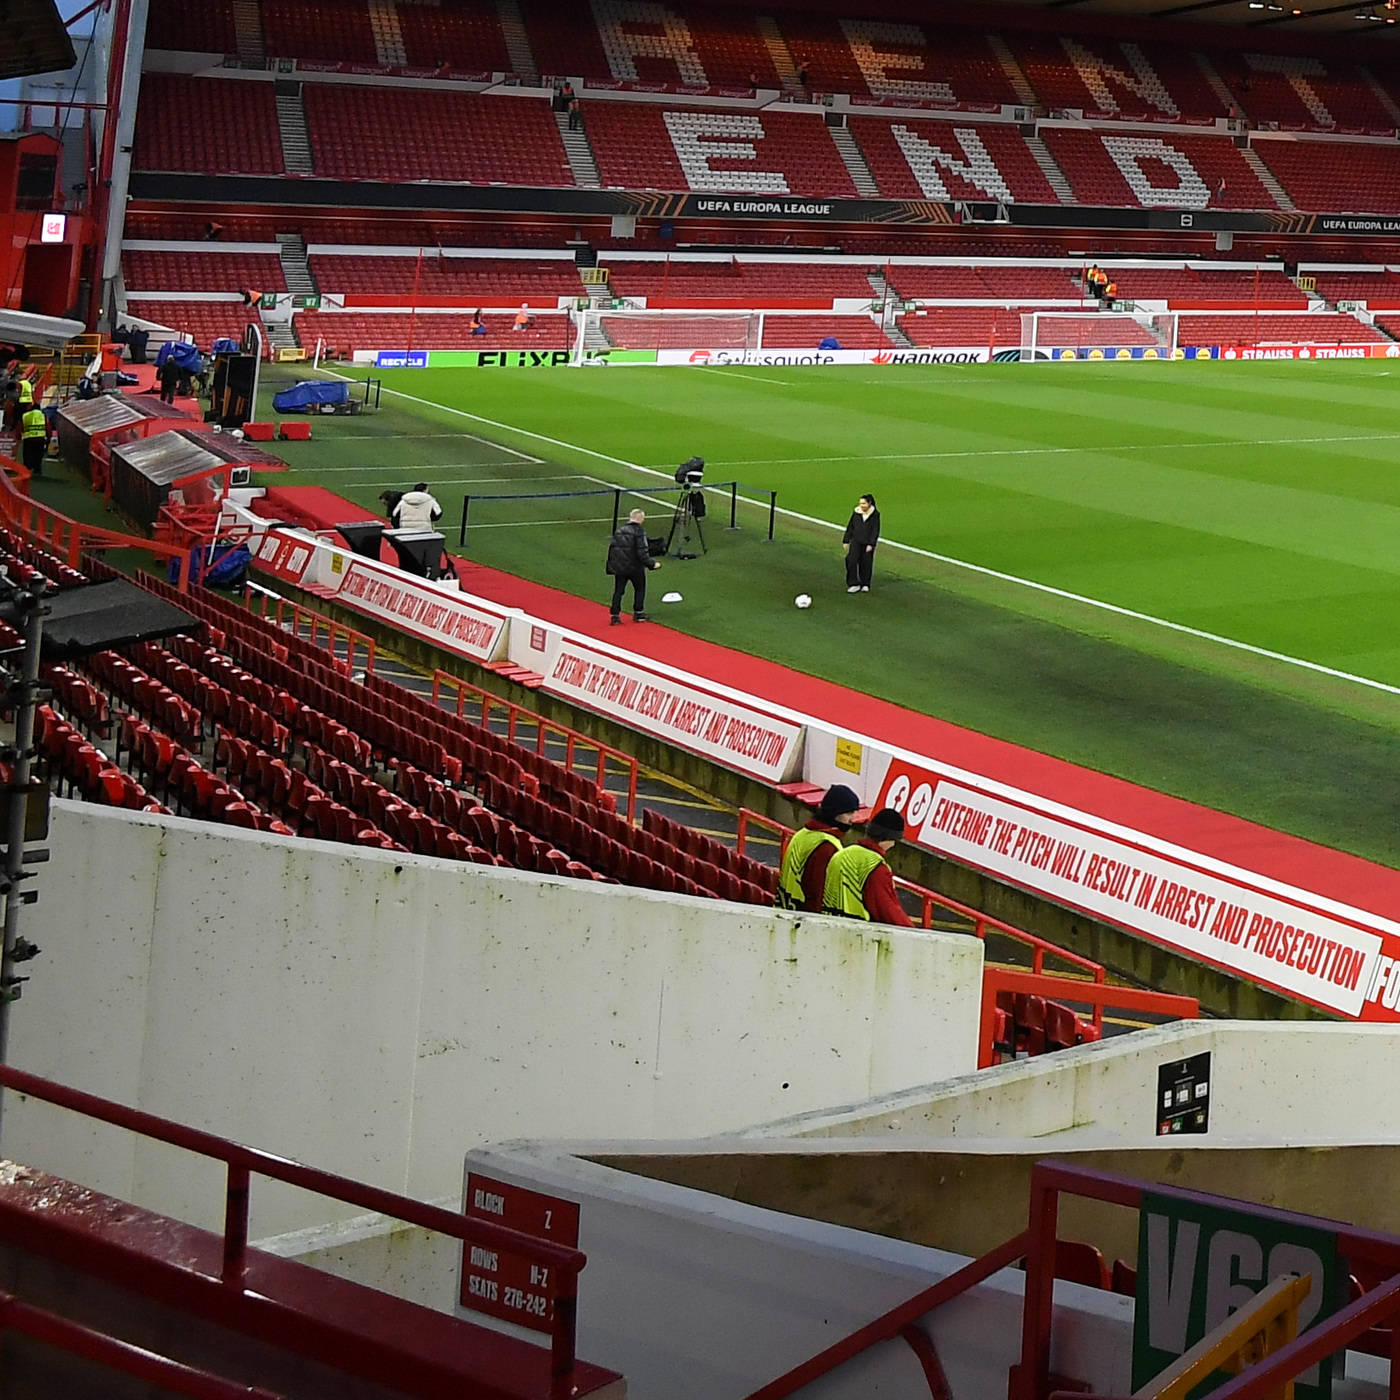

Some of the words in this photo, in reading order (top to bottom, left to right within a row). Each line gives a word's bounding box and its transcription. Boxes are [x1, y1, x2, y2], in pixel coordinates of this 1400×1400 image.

[661, 111, 1211, 207] END
[697, 201, 731, 212] UEFA
[733, 202, 781, 213] EUROPA
[784, 203, 830, 215] LEAGUE
[1323, 220, 1347, 229] UEFA
[1348, 221, 1381, 230] EUROPA
[1241, 348, 1294, 360] STRAUSS
[1315, 348, 1366, 359] STRAUSS
[552, 652, 592, 687] ENTERING
[584, 664, 605, 694] THE
[596, 667, 627, 701] PITCH
[618, 676, 642, 711] WILL
[636, 683, 672, 720] RESULT
[663, 695, 681, 727] IN
[673, 699, 712, 738] ARREST
[704, 711, 728, 745] AND
[720, 717, 789, 768] PROSECUTION
[930, 798, 993, 847] ENTERING
[987, 816, 1018, 856] THE
[1011, 825, 1056, 867] PITCH
[1049, 840, 1088, 882] WILL
[1080, 851, 1143, 904] RESULT
[1136, 871, 1157, 910] IN
[1150, 879, 1217, 933] ARREST
[1208, 899, 1250, 946] AND
[1243, 915, 1367, 991] PROSECUTION
[474, 1189, 505, 1216] BLOCK
[544, 1210, 552, 1230] Z
[470, 1245, 498, 1272] ROWS
[468, 1274, 499, 1301] SEATS
